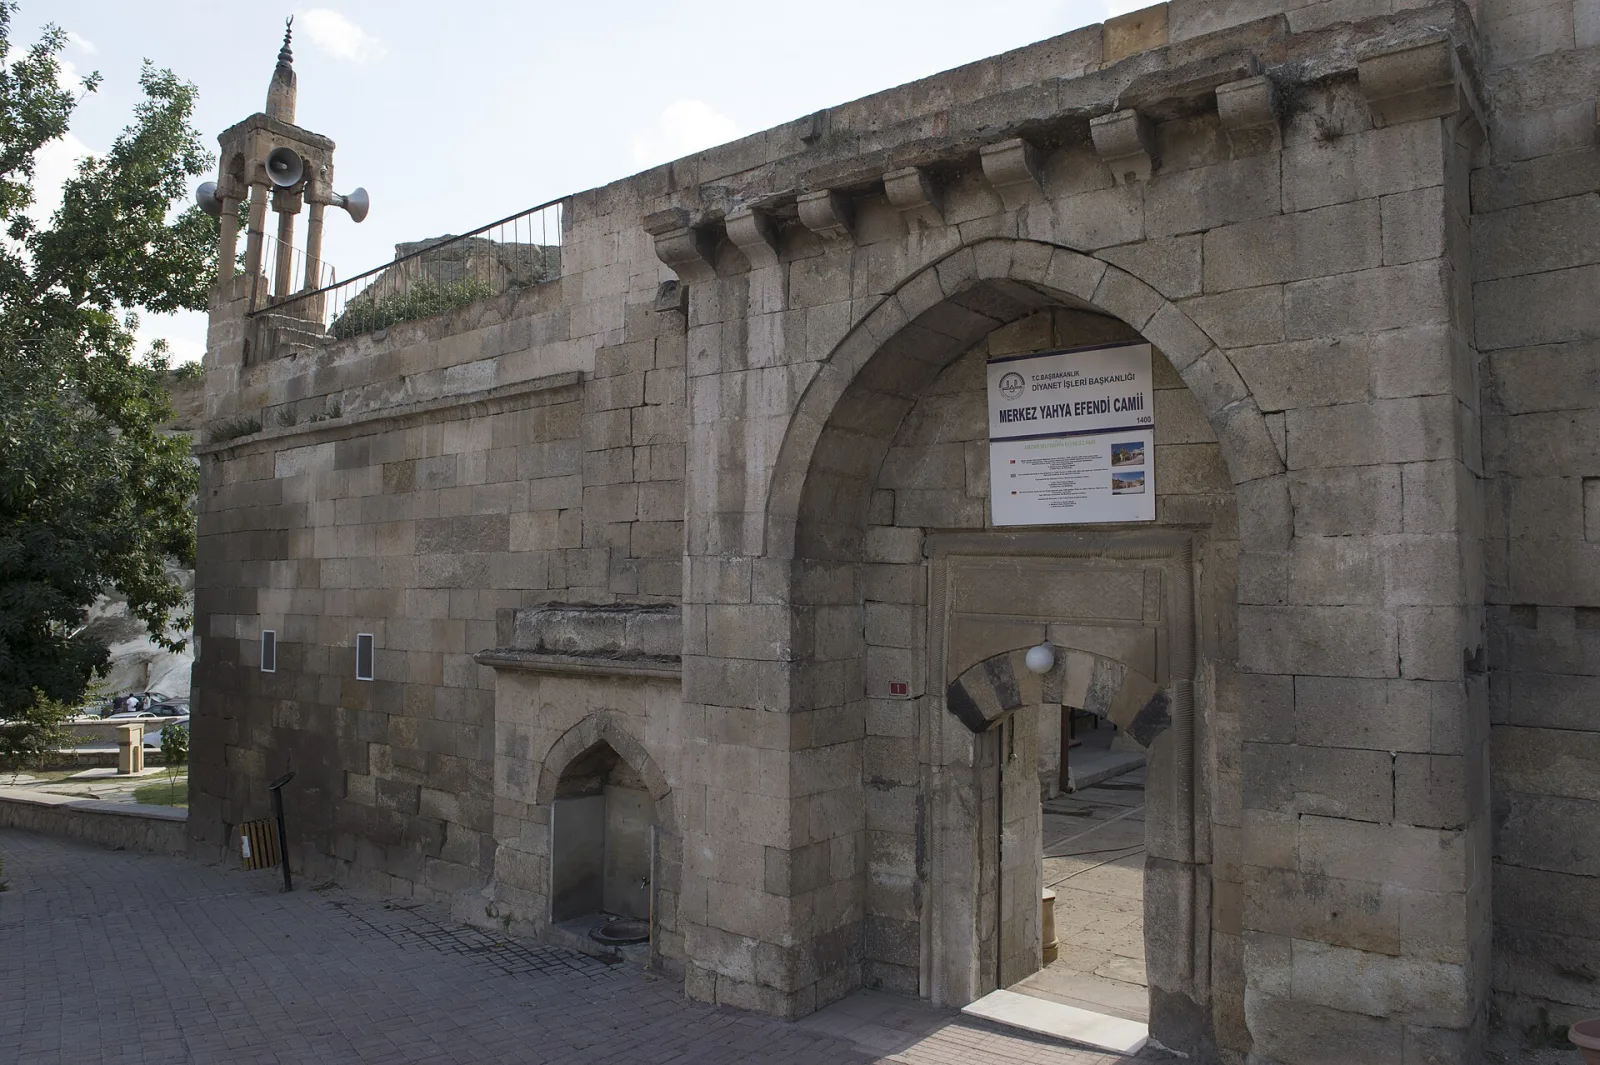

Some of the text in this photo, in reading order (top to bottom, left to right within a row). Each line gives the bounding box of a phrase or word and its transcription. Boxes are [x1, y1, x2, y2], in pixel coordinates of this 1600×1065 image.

[1032, 372, 1135, 391] DİYANET İŞLERİ BAŞKANLIĞI
[999, 392, 1144, 423] MERKEZ YAHYA EFENDİ CAMİİ
[1136, 416, 1152, 424] 1400
